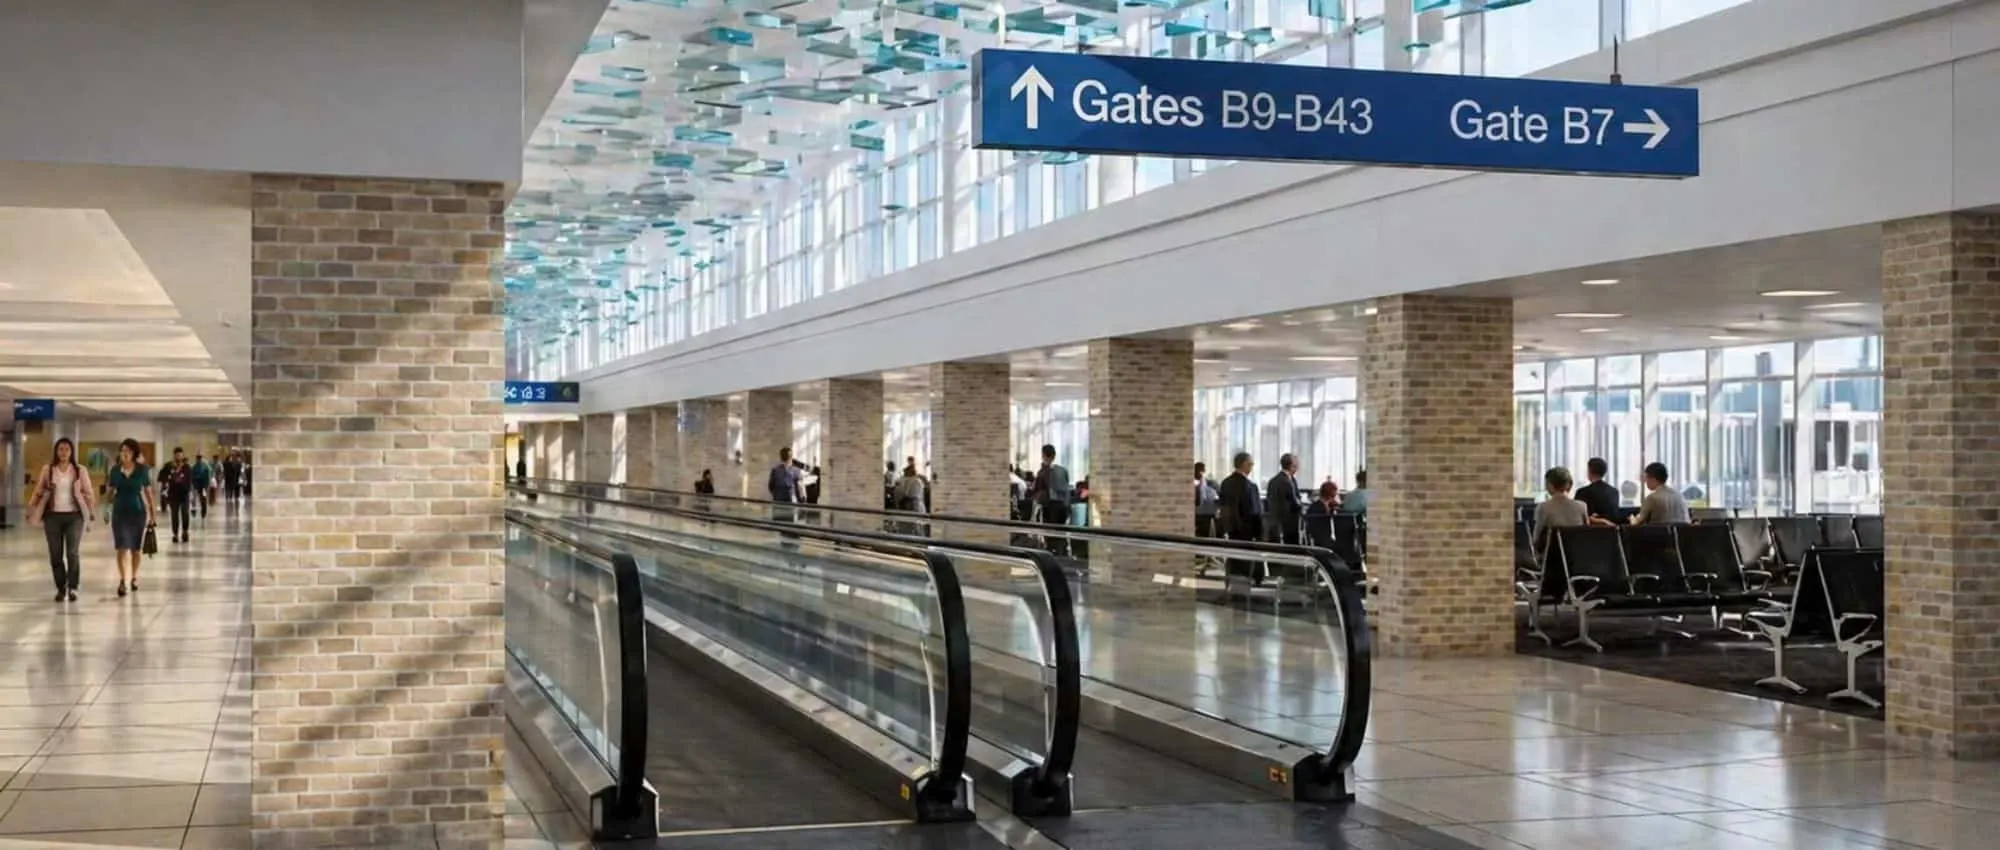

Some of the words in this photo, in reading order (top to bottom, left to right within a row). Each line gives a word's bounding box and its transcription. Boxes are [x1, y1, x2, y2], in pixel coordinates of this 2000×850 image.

[1072, 79, 1204, 127] Gates
[1222, 90, 1374, 135] B9-B43
[1450, 99, 1548, 143] Gate
[1564, 107, 1614, 145] B7
